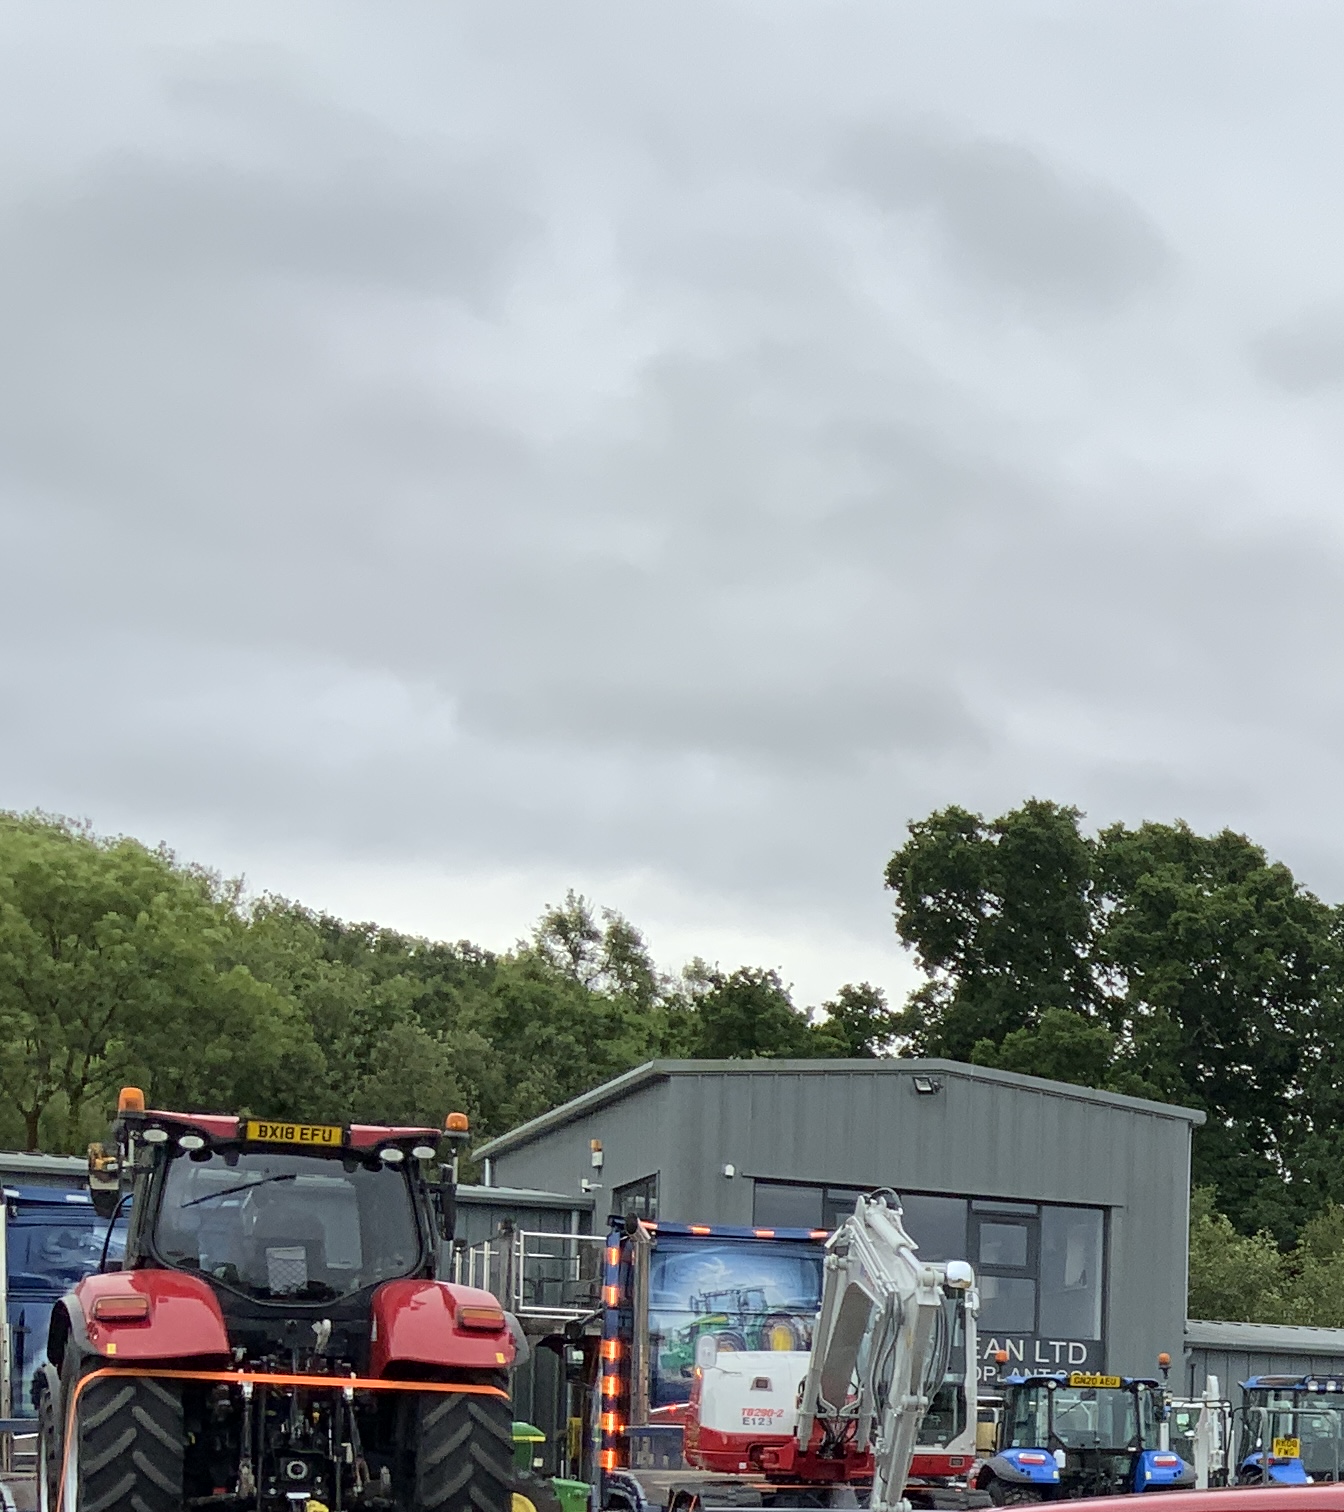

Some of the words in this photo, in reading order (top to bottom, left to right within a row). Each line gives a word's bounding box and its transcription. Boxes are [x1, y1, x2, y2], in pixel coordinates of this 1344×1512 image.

[258, 1125, 295, 1139] BX18
[300, 1127, 332, 1142] EFU
[1035, 1340, 1087, 1364] LTD
